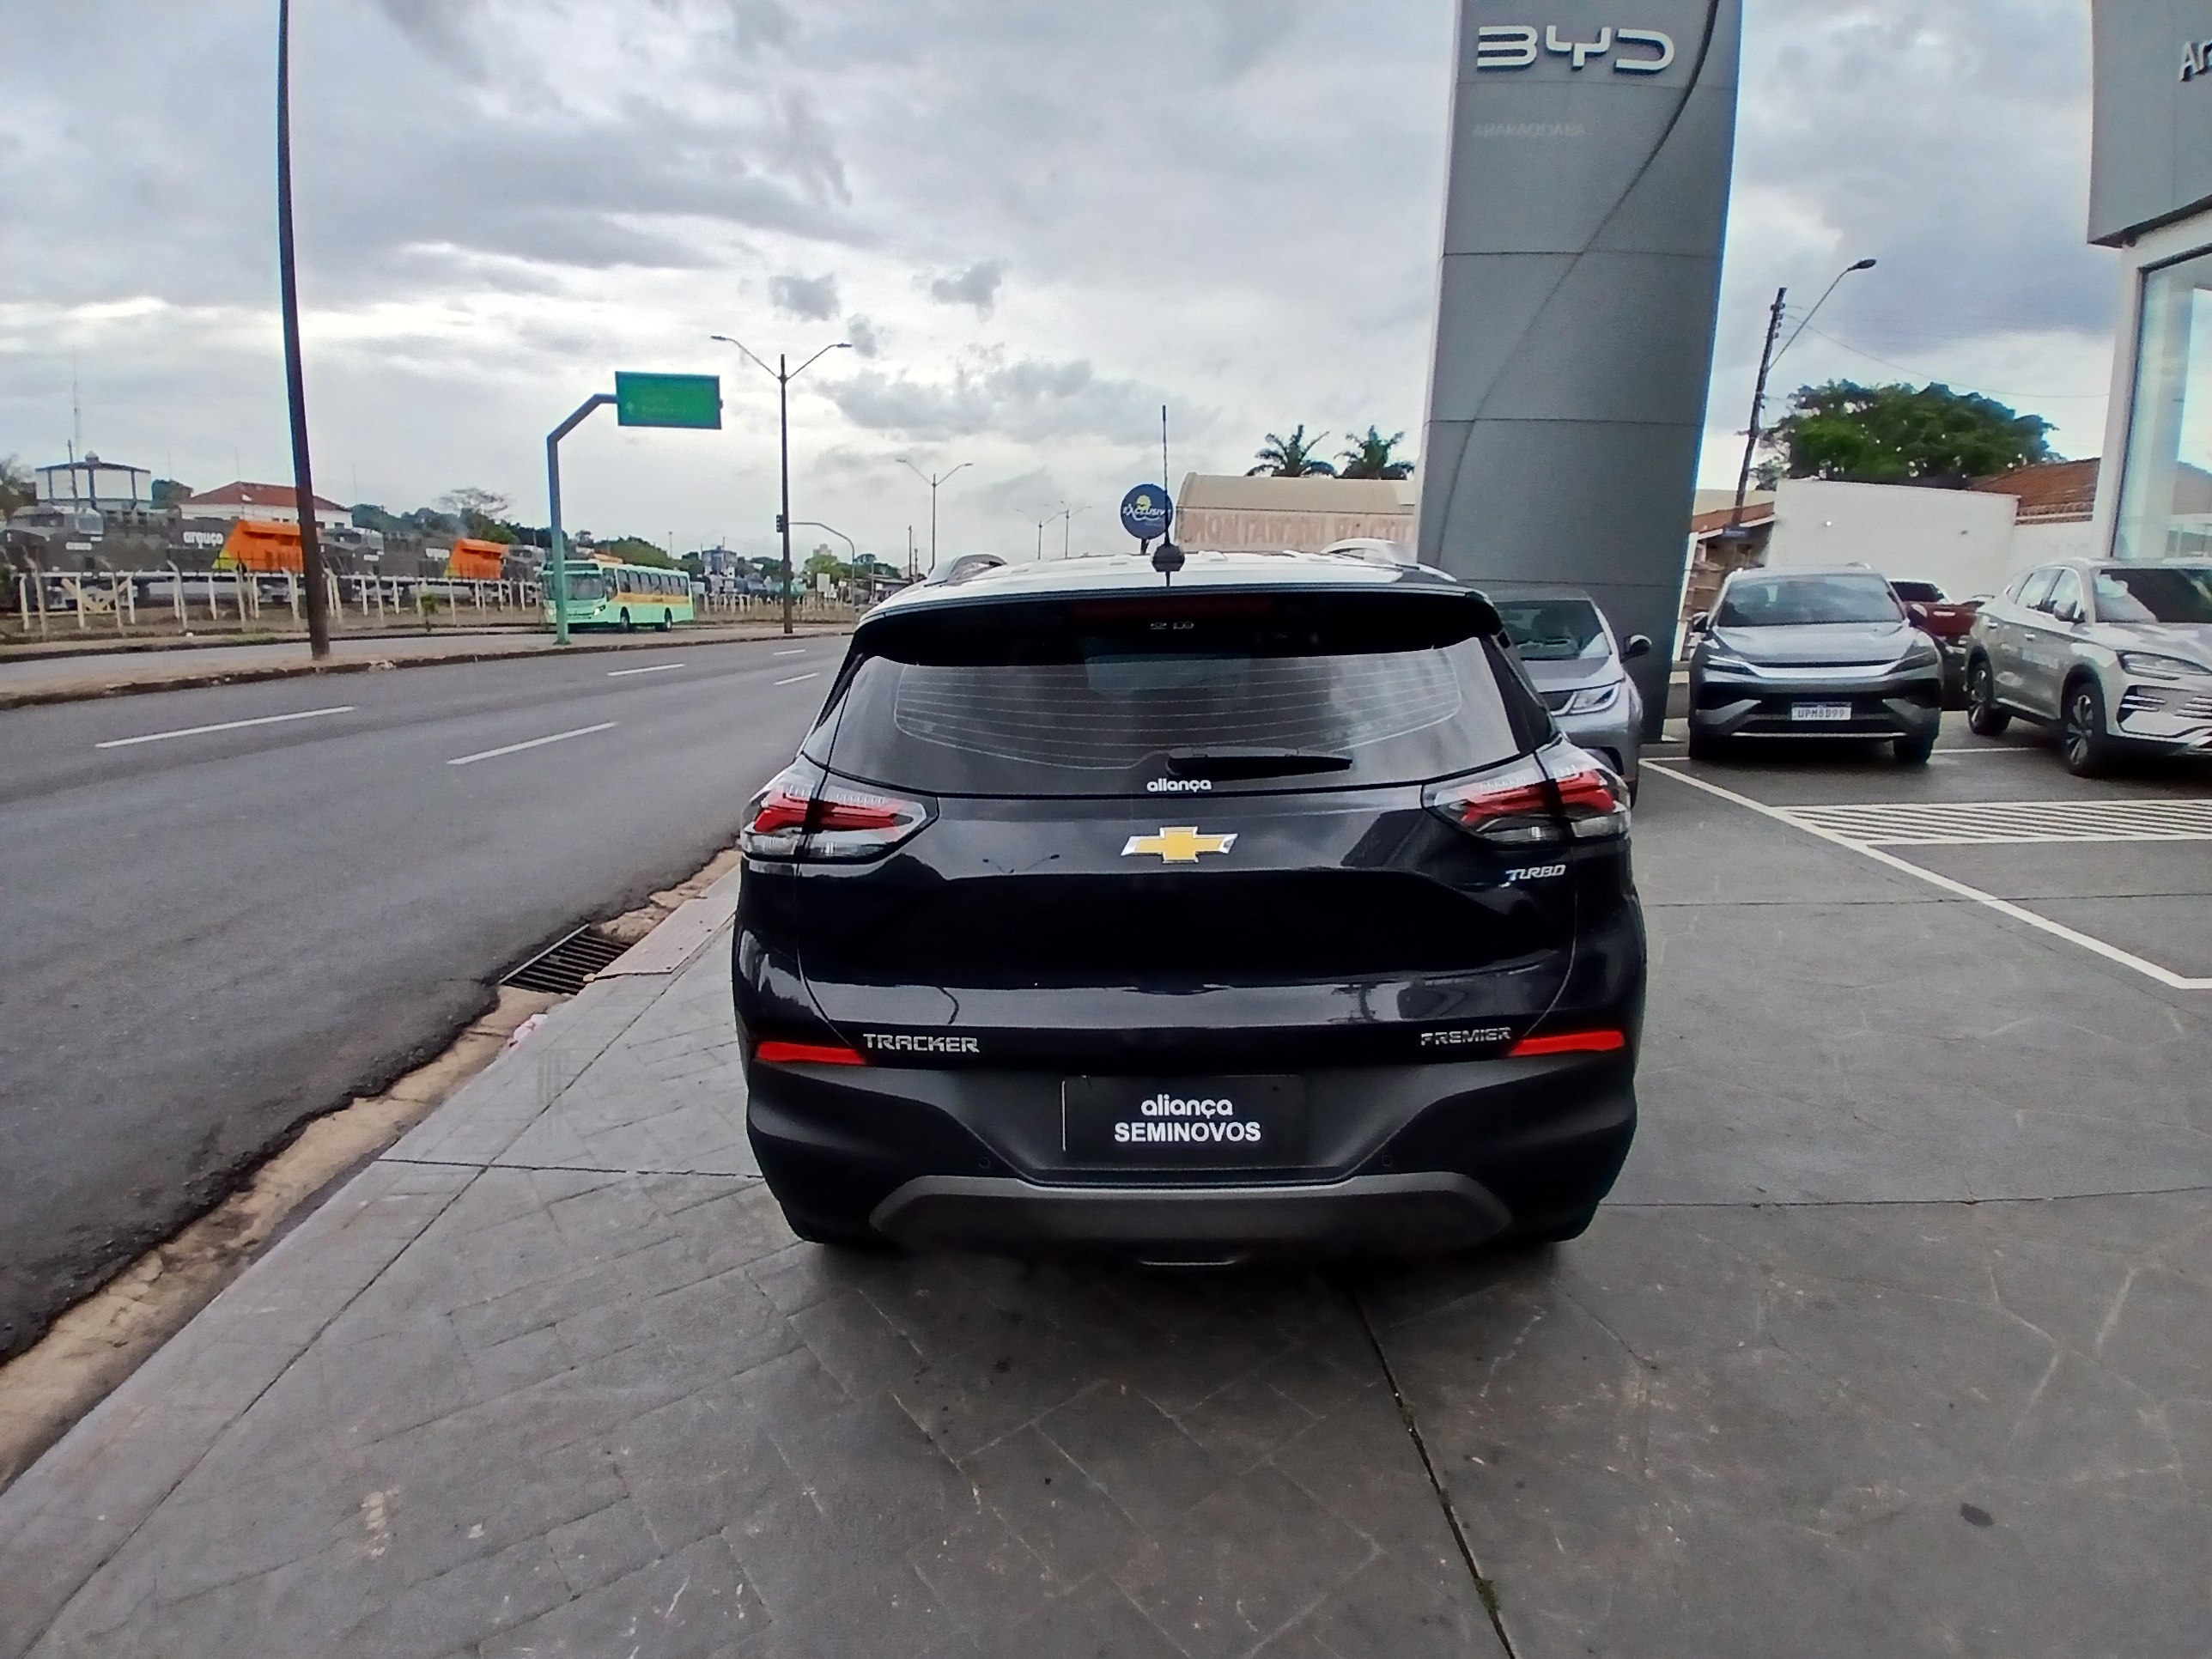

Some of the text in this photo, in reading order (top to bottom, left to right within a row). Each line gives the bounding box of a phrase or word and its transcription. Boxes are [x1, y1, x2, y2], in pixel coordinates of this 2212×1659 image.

[1477, 25, 1675, 70] BYD
[1146, 778, 1212, 793] aliança
[1505, 864, 1566, 881] TURBO
[863, 1033, 980, 1053] TRACKER
[1421, 1027, 1511, 1046] PREMIER
[1140, 1094, 1233, 1119] aliança
[1114, 1121, 1261, 1142] SEMINOVOS
